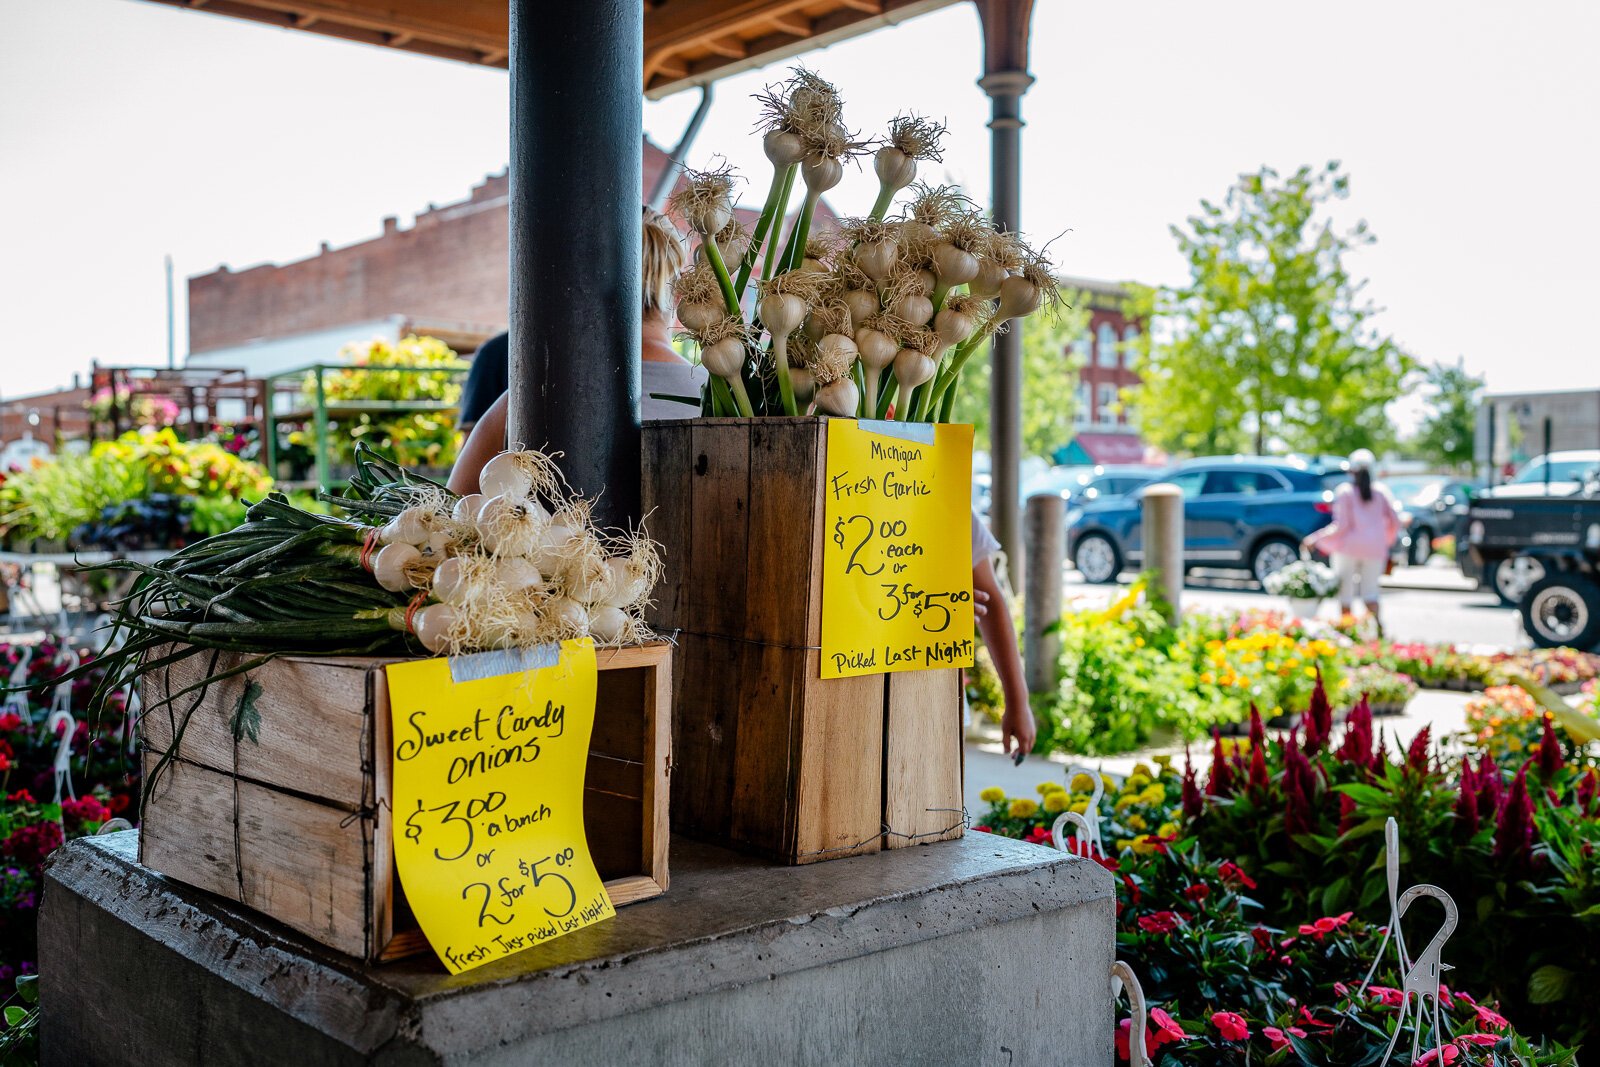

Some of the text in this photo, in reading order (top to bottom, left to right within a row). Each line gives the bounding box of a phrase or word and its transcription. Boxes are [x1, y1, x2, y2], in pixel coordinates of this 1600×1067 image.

[871, 441, 922, 471] Michigan
[831, 471, 931, 500] Fresh Garlic
[893, 562, 907, 574] or
[879, 584, 901, 620] 3
[901, 583, 925, 605] for
[831, 650, 876, 673] Picked
[885, 646, 921, 665] Last
[396, 700, 565, 762] Sweet Candy
[505, 803, 552, 832] bunch
[476, 849, 496, 867] or
[462, 882, 514, 928] 2
[445, 946, 490, 971] Fresh
